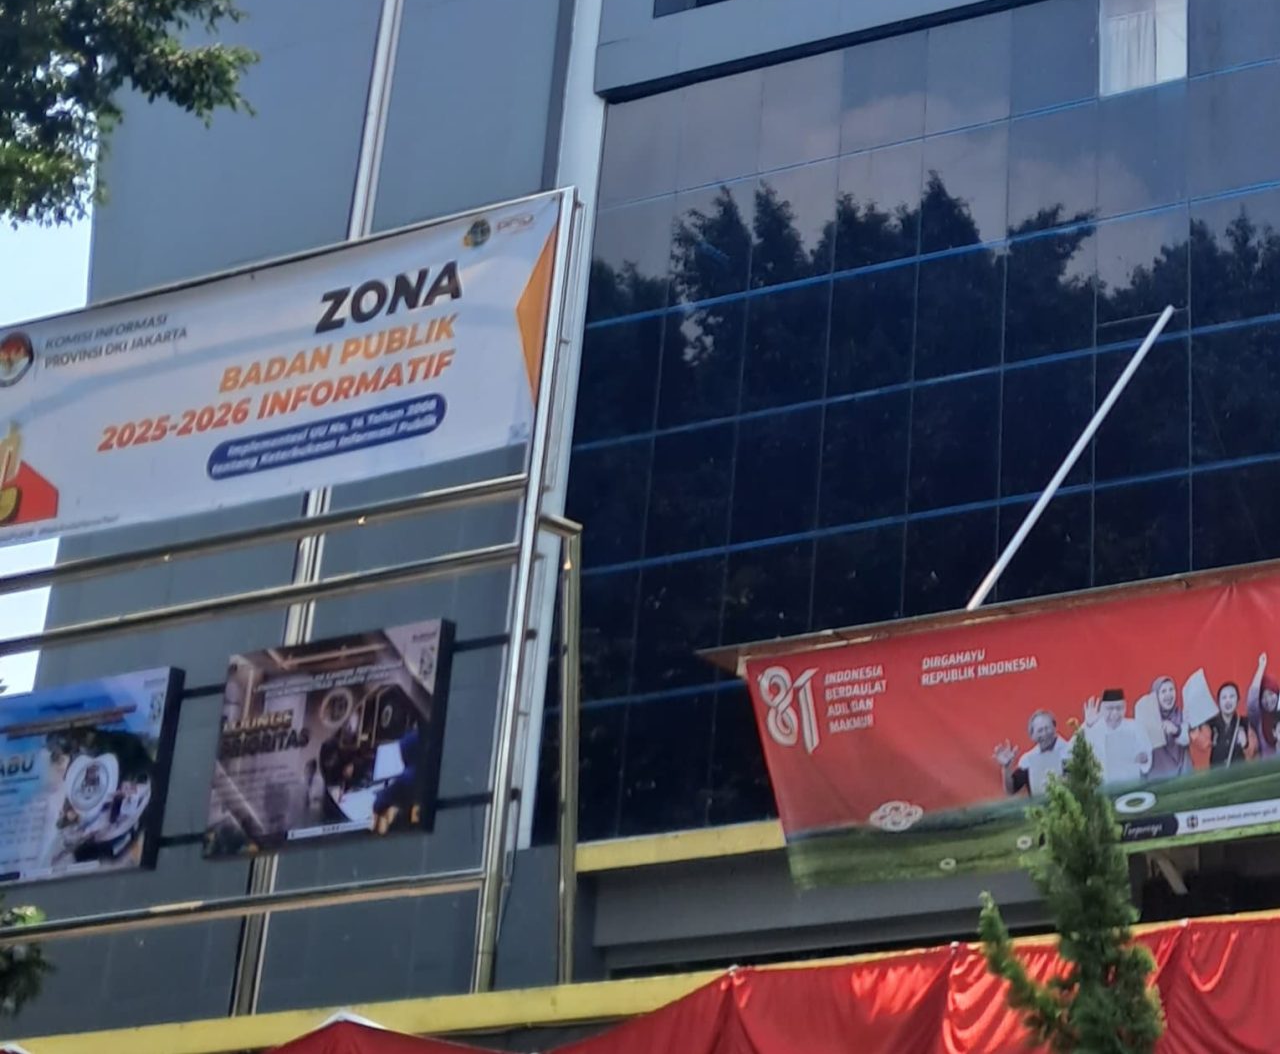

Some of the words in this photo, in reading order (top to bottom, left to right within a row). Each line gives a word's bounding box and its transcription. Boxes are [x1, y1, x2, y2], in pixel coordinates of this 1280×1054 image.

[314, 260, 463, 334] ZONA
[94, 313, 169, 341] INFORMASI
[44, 345, 103, 370] PROVINSI
[104, 341, 129, 356] DKI
[130, 326, 188, 351] JAKARTA
[219, 341, 333, 393] BADAN
[339, 312, 458, 365] PUBLIK
[97, 397, 251, 452] 2025-2026
[257, 349, 456, 421] INFORMATIF
[921, 648, 985, 671] DIRGAHAYU
[921, 668, 976, 687] REPUBLIK
[977, 655, 1038, 678] INDONESIA
[824, 664, 884, 686] INDONESIA
[825, 679, 887, 701] BERDAULAT
[827, 700, 850, 717] ADIL
[851, 697, 874, 713] DAN
[829, 714, 874, 734] MAKMUR
